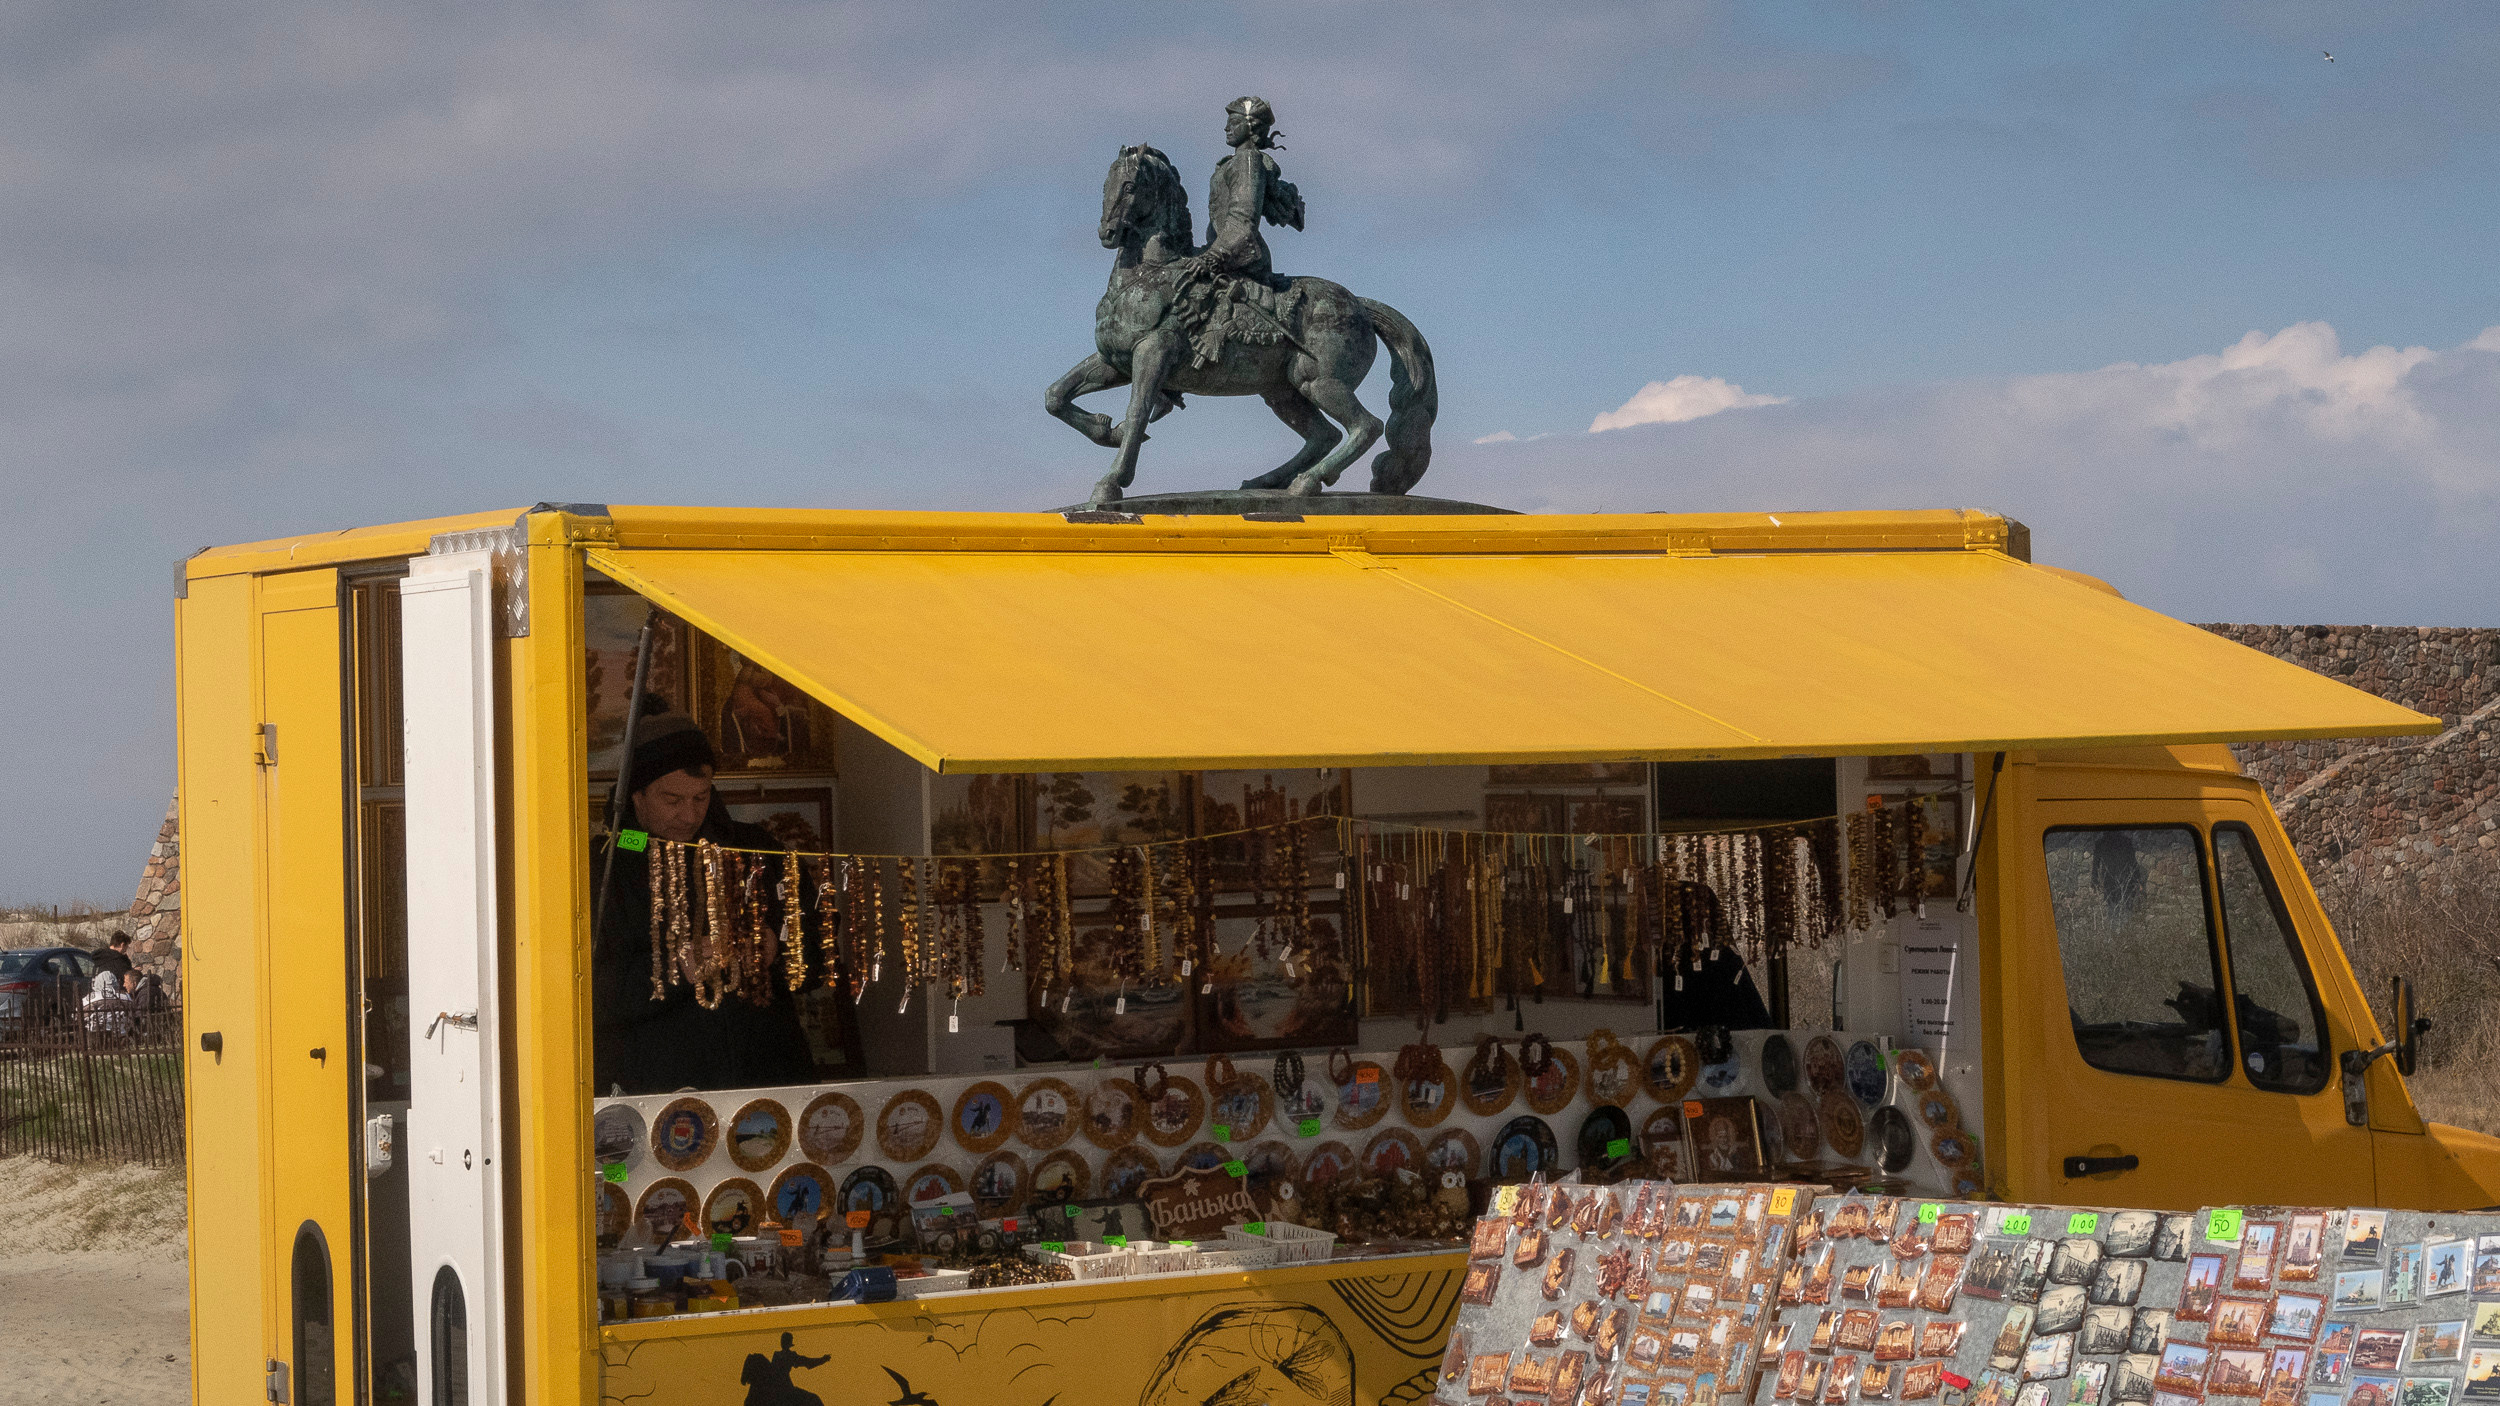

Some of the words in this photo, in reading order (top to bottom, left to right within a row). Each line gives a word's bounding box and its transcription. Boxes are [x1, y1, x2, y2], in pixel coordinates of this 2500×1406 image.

[623, 837, 639, 845] 100
[1775, 1195, 1787, 1209] 80
[1150, 1190, 1252, 1228] Банька
[2005, 1220, 2027, 1231] 200
[2072, 1218, 2095, 1229] 100
[2213, 1219, 2230, 1235] 50
